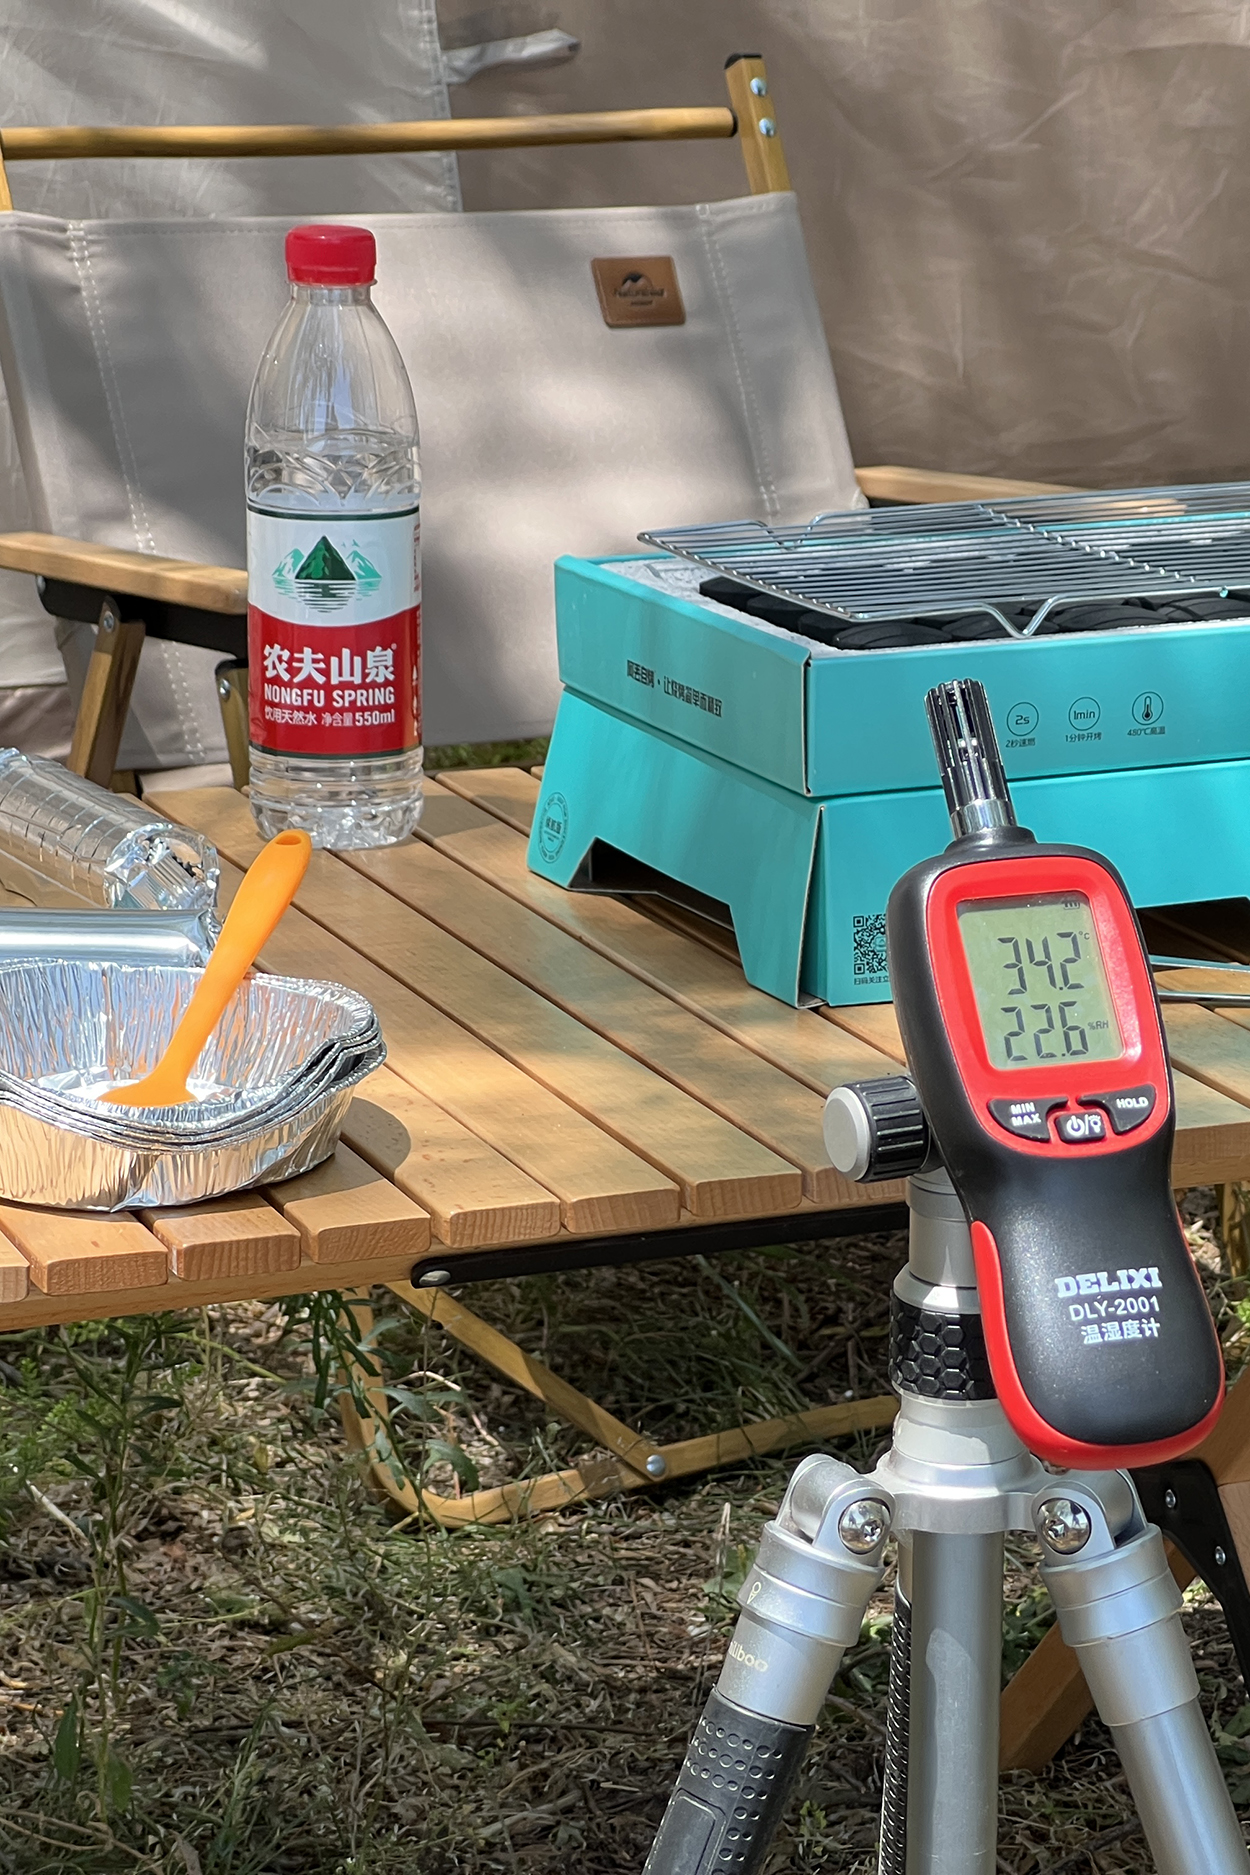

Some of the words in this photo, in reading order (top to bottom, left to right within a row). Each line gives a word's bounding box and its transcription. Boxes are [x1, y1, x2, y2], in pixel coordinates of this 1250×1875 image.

[263, 643, 395, 685] 农夫山泉
[264, 683, 325, 708] NONGFU
[332, 686, 395, 708] SPRING
[264, 705, 317, 726] 饮用天然水
[1015, 714, 1030, 726] 2s
[1073, 708, 1096, 721] 1min
[997, 931, 1085, 995] 34.2
[1000, 1000, 1089, 1062] 22.6
[1010, 1102, 1036, 1114] MIN
[1116, 1096, 1149, 1109] HOLD
[1011, 1113, 1042, 1126] MAX
[1054, 1266, 1163, 1298] DELIXI
[1068, 1295, 1160, 1321] DLY-2001
[1081, 1317, 1161, 1345] 温湿度计
